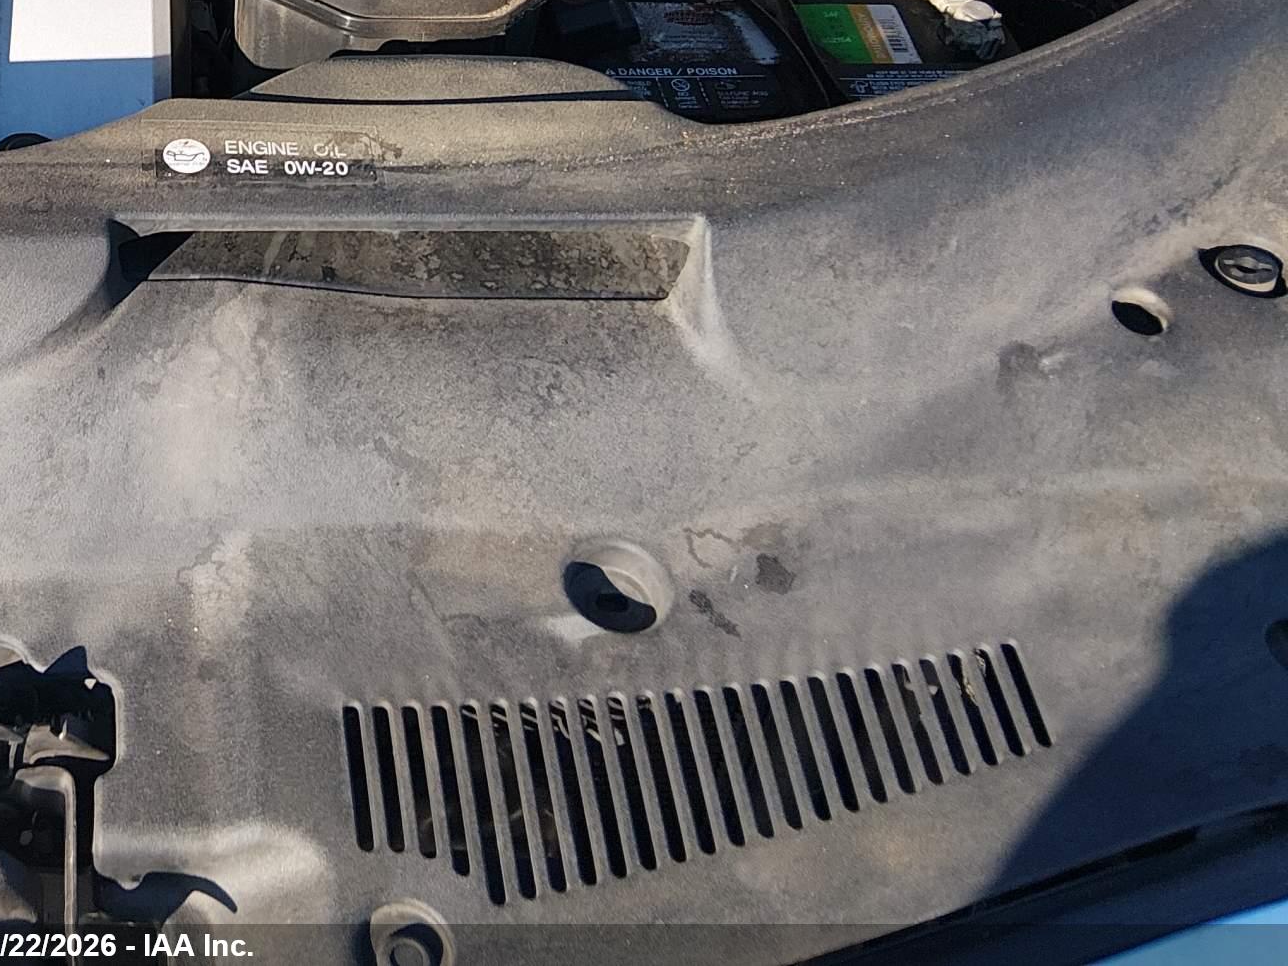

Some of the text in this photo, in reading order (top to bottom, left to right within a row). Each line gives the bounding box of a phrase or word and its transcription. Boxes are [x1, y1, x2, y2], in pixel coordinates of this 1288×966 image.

[617, 67, 673, 76] DANGER
[686, 67, 738, 76] POISON
[224, 140, 299, 155] ENGINE
[226, 159, 349, 176] SAE 0W-20
